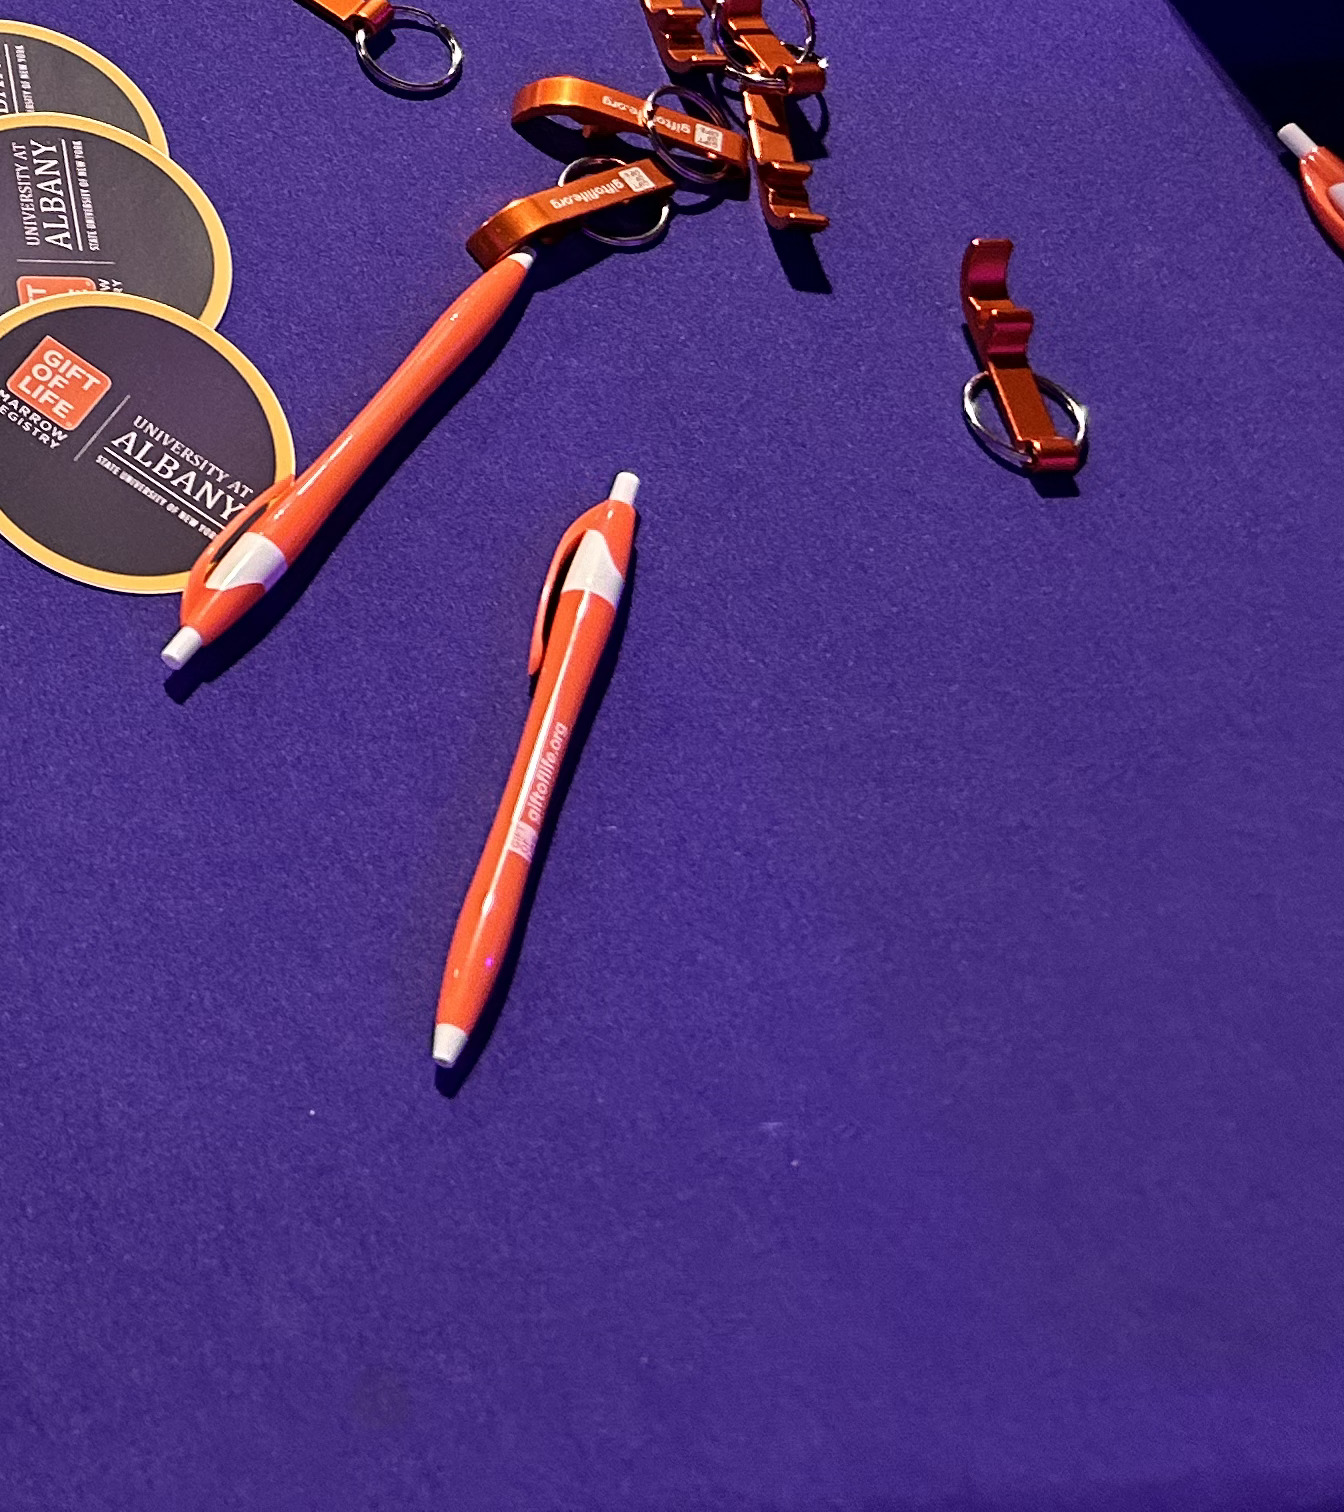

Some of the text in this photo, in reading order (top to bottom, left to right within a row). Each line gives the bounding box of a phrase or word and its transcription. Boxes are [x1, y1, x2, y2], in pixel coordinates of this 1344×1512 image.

[15, 162, 40, 246] UNIVERSITY
[30, 140, 73, 251] ALBANY
[17, 376, 75, 419] LIFE
[32, 365, 69, 389] OF
[43, 350, 101, 391] GIFT
[112, 432, 245, 522] ALBANY
[133, 416, 229, 483] UNIVERSITY
